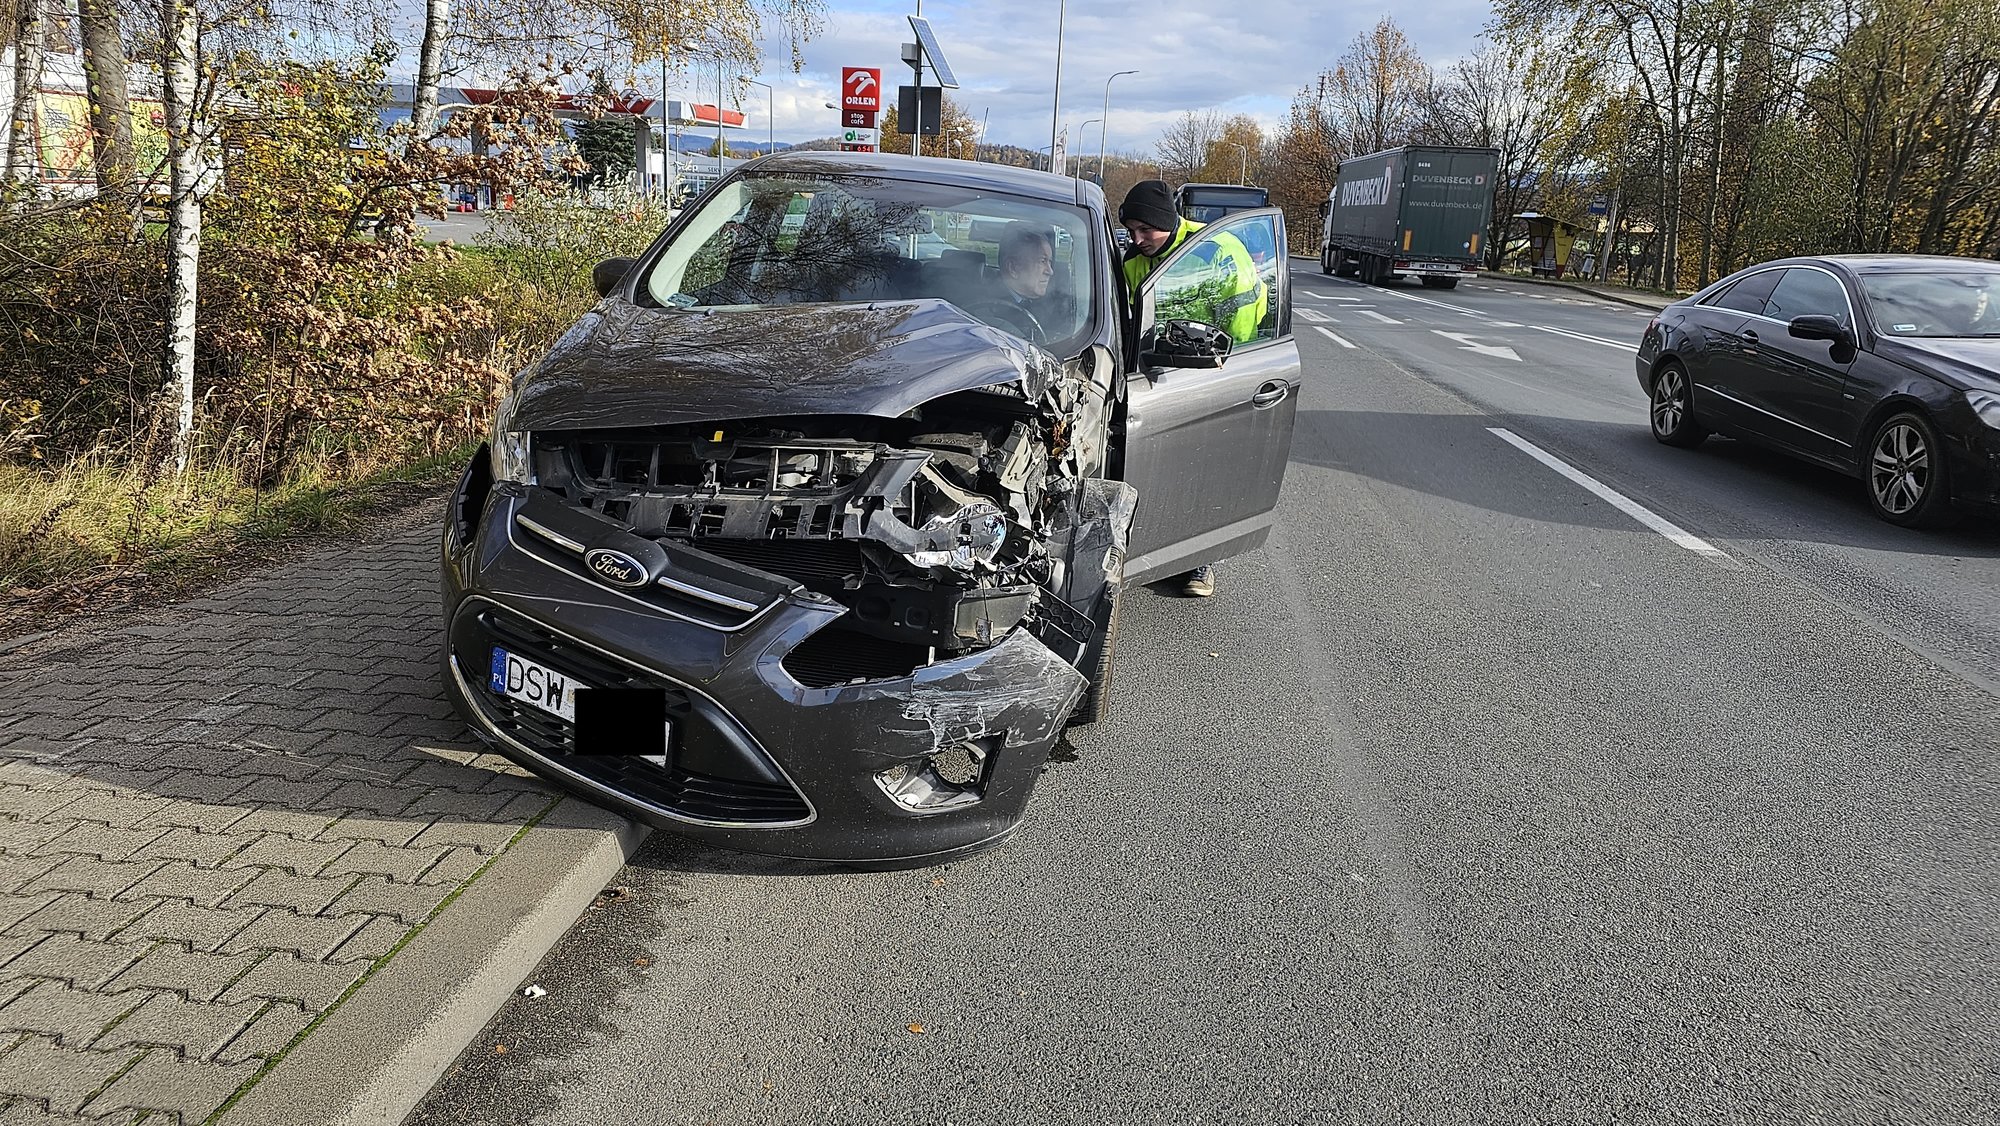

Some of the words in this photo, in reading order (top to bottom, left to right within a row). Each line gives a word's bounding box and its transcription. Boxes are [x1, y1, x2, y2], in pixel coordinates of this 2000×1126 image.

[846, 97, 875, 105] ORLEN
[1413, 175, 1472, 184] DUVENBECK
[1341, 177, 1383, 206] DUVENBECK
[1409, 200, 1482, 209] www.duvenbeck.de
[595, 553, 633, 581] Ford
[493, 672, 504, 686] PL
[508, 656, 565, 711] DSW
